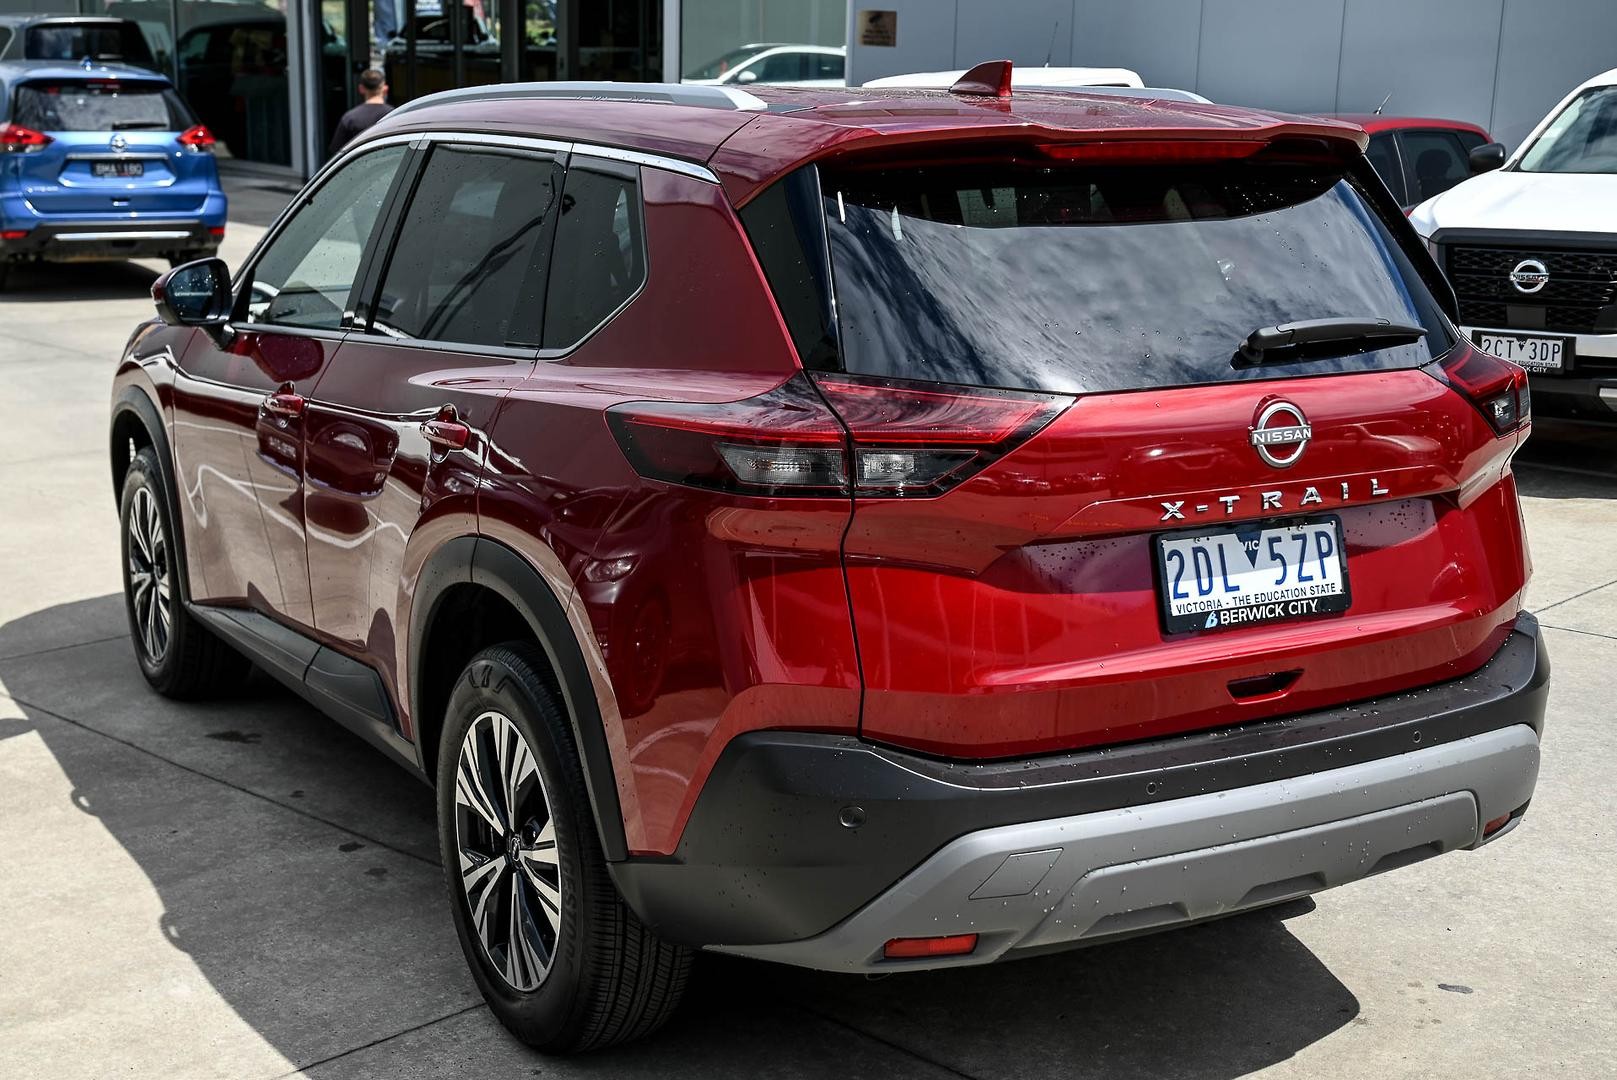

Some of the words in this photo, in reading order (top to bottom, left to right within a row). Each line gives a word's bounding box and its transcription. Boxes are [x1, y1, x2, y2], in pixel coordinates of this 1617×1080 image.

[1483, 338, 1514, 359] 2CT
[1529, 341, 1561, 362] 3DP
[1253, 428, 1312, 444] NISSAN
[1160, 478, 1389, 521] X-TRAIL
[1242, 540, 1260, 551] VIC
[1166, 543, 1240, 600] 2DL
[1267, 531, 1334, 586] 5ZP
[1175, 599, 1223, 615] VICTORIA
[1231, 594, 1252, 607] THE
[1254, 587, 1307, 603] EDUCATION
[1309, 583, 1337, 596] STATE
[1220, 603, 1285, 626] BERWICK
[1288, 599, 1319, 616] CITY
